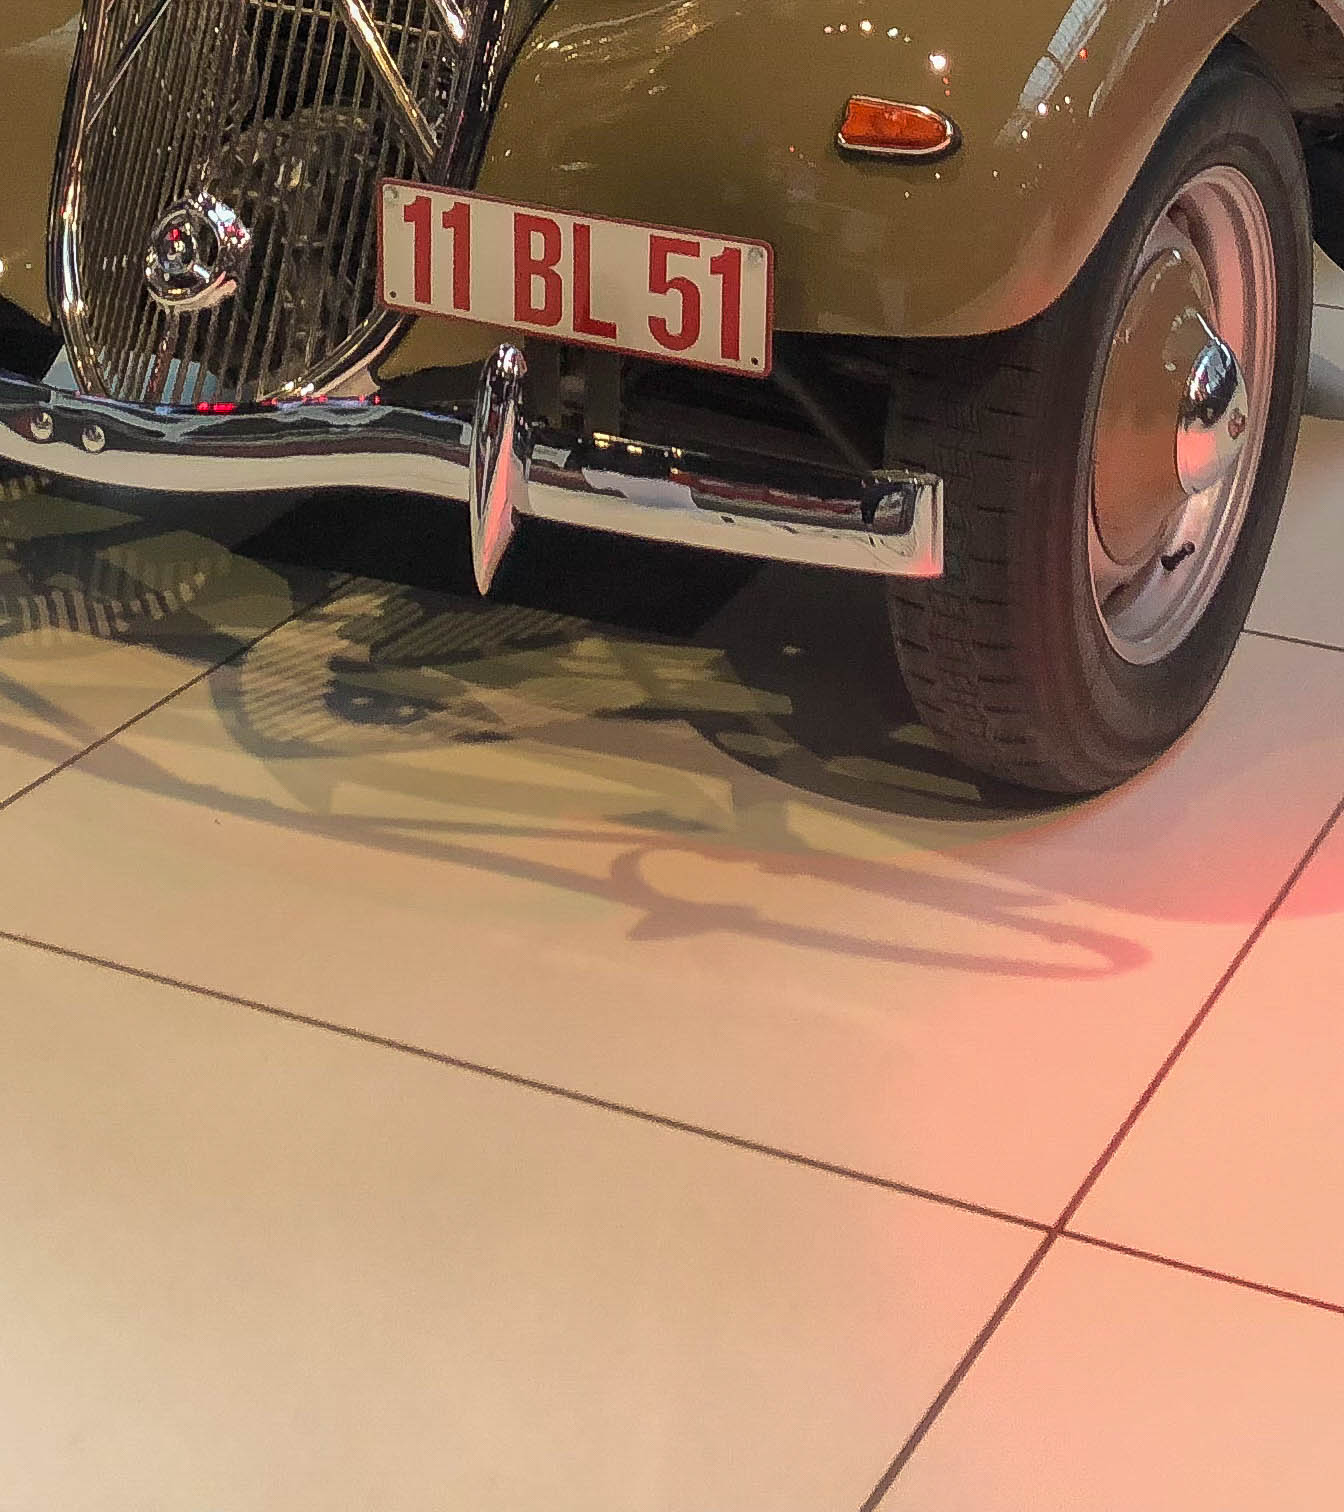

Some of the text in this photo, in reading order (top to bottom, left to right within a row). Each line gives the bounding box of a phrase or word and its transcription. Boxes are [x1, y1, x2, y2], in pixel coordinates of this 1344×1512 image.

[403, 195, 742, 361] 11 BL 51
